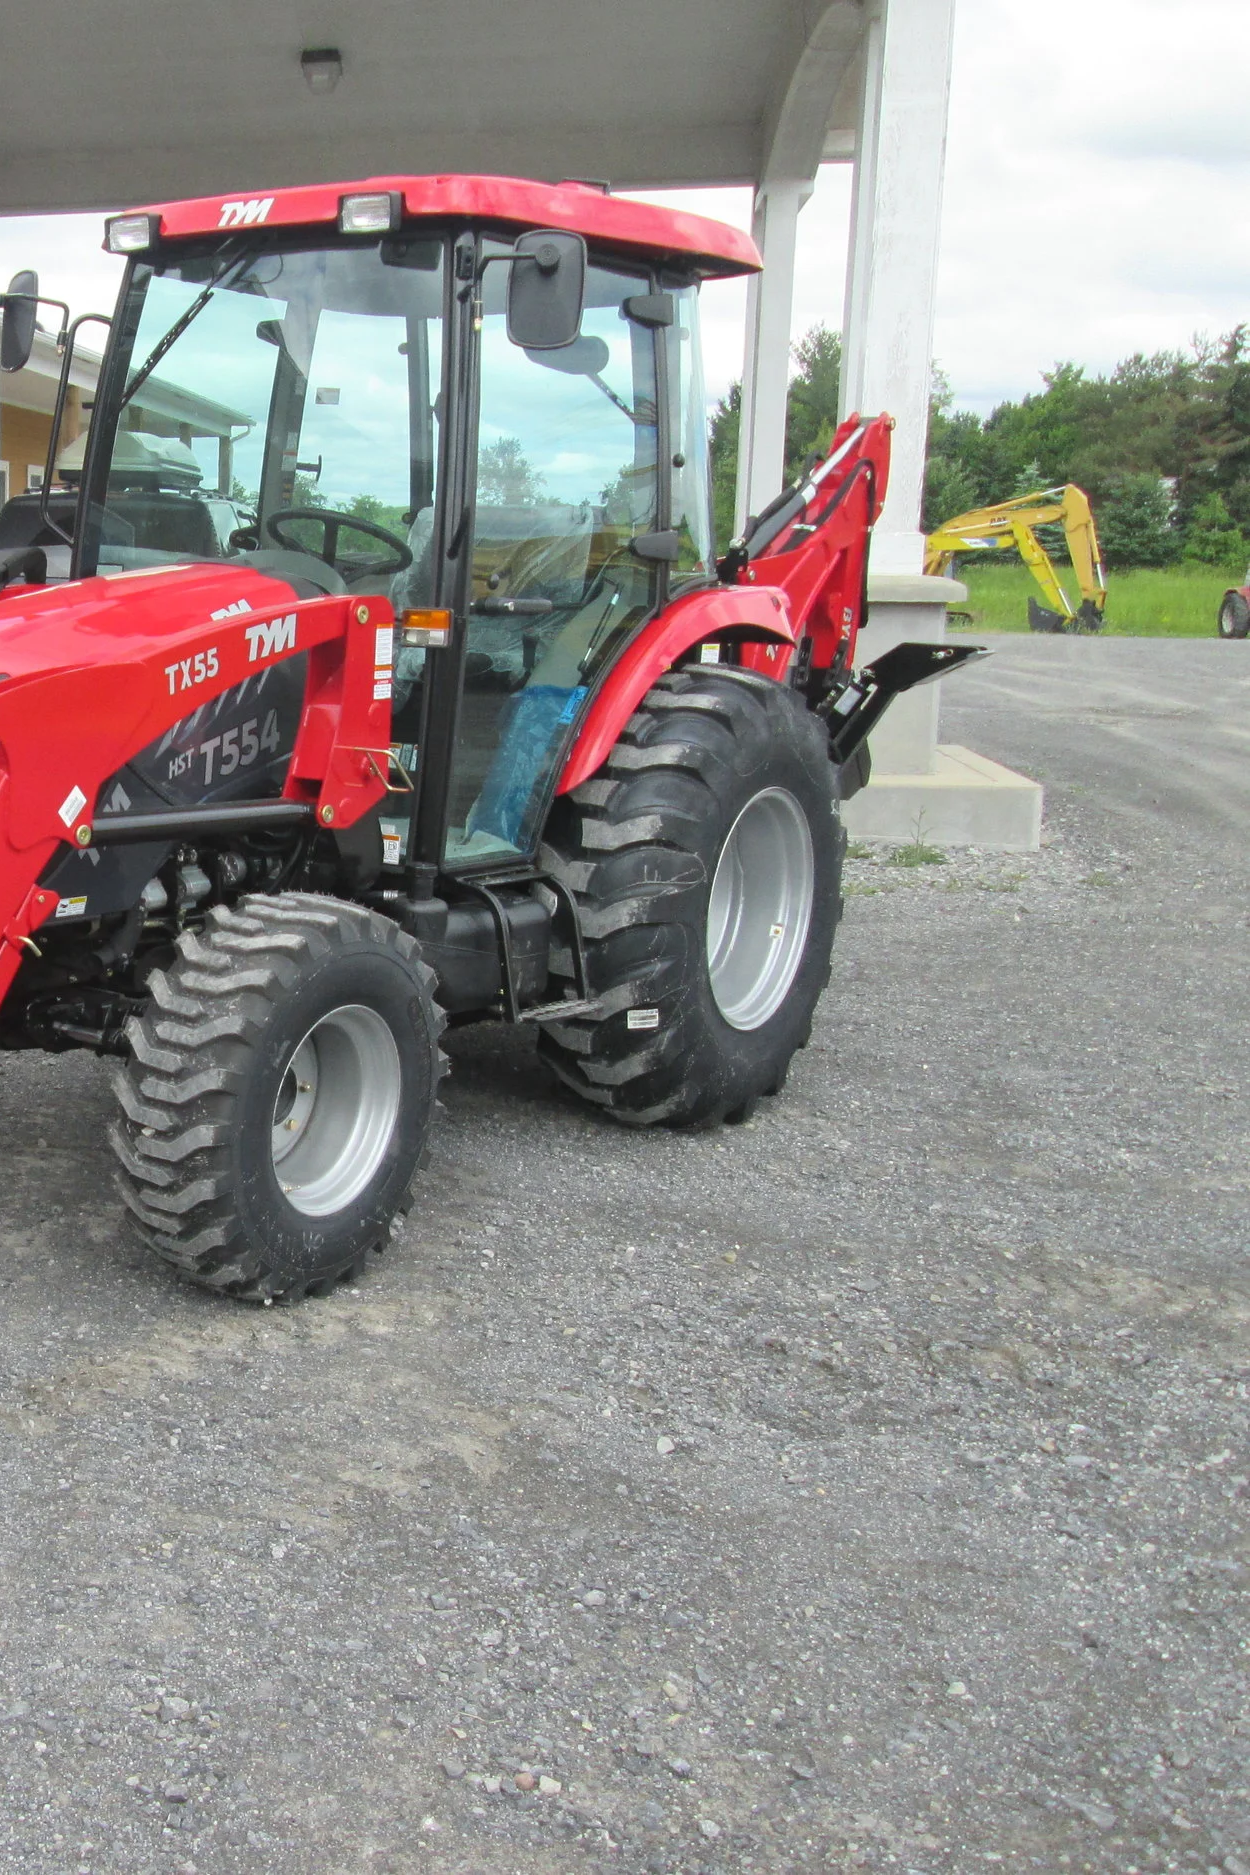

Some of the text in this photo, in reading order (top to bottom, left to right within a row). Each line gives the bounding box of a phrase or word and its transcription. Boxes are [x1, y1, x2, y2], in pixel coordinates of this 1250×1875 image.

[218, 197, 275, 227] TYM
[164, 612, 297, 696] TX55 TYM
[168, 708, 280, 786] HST T554
